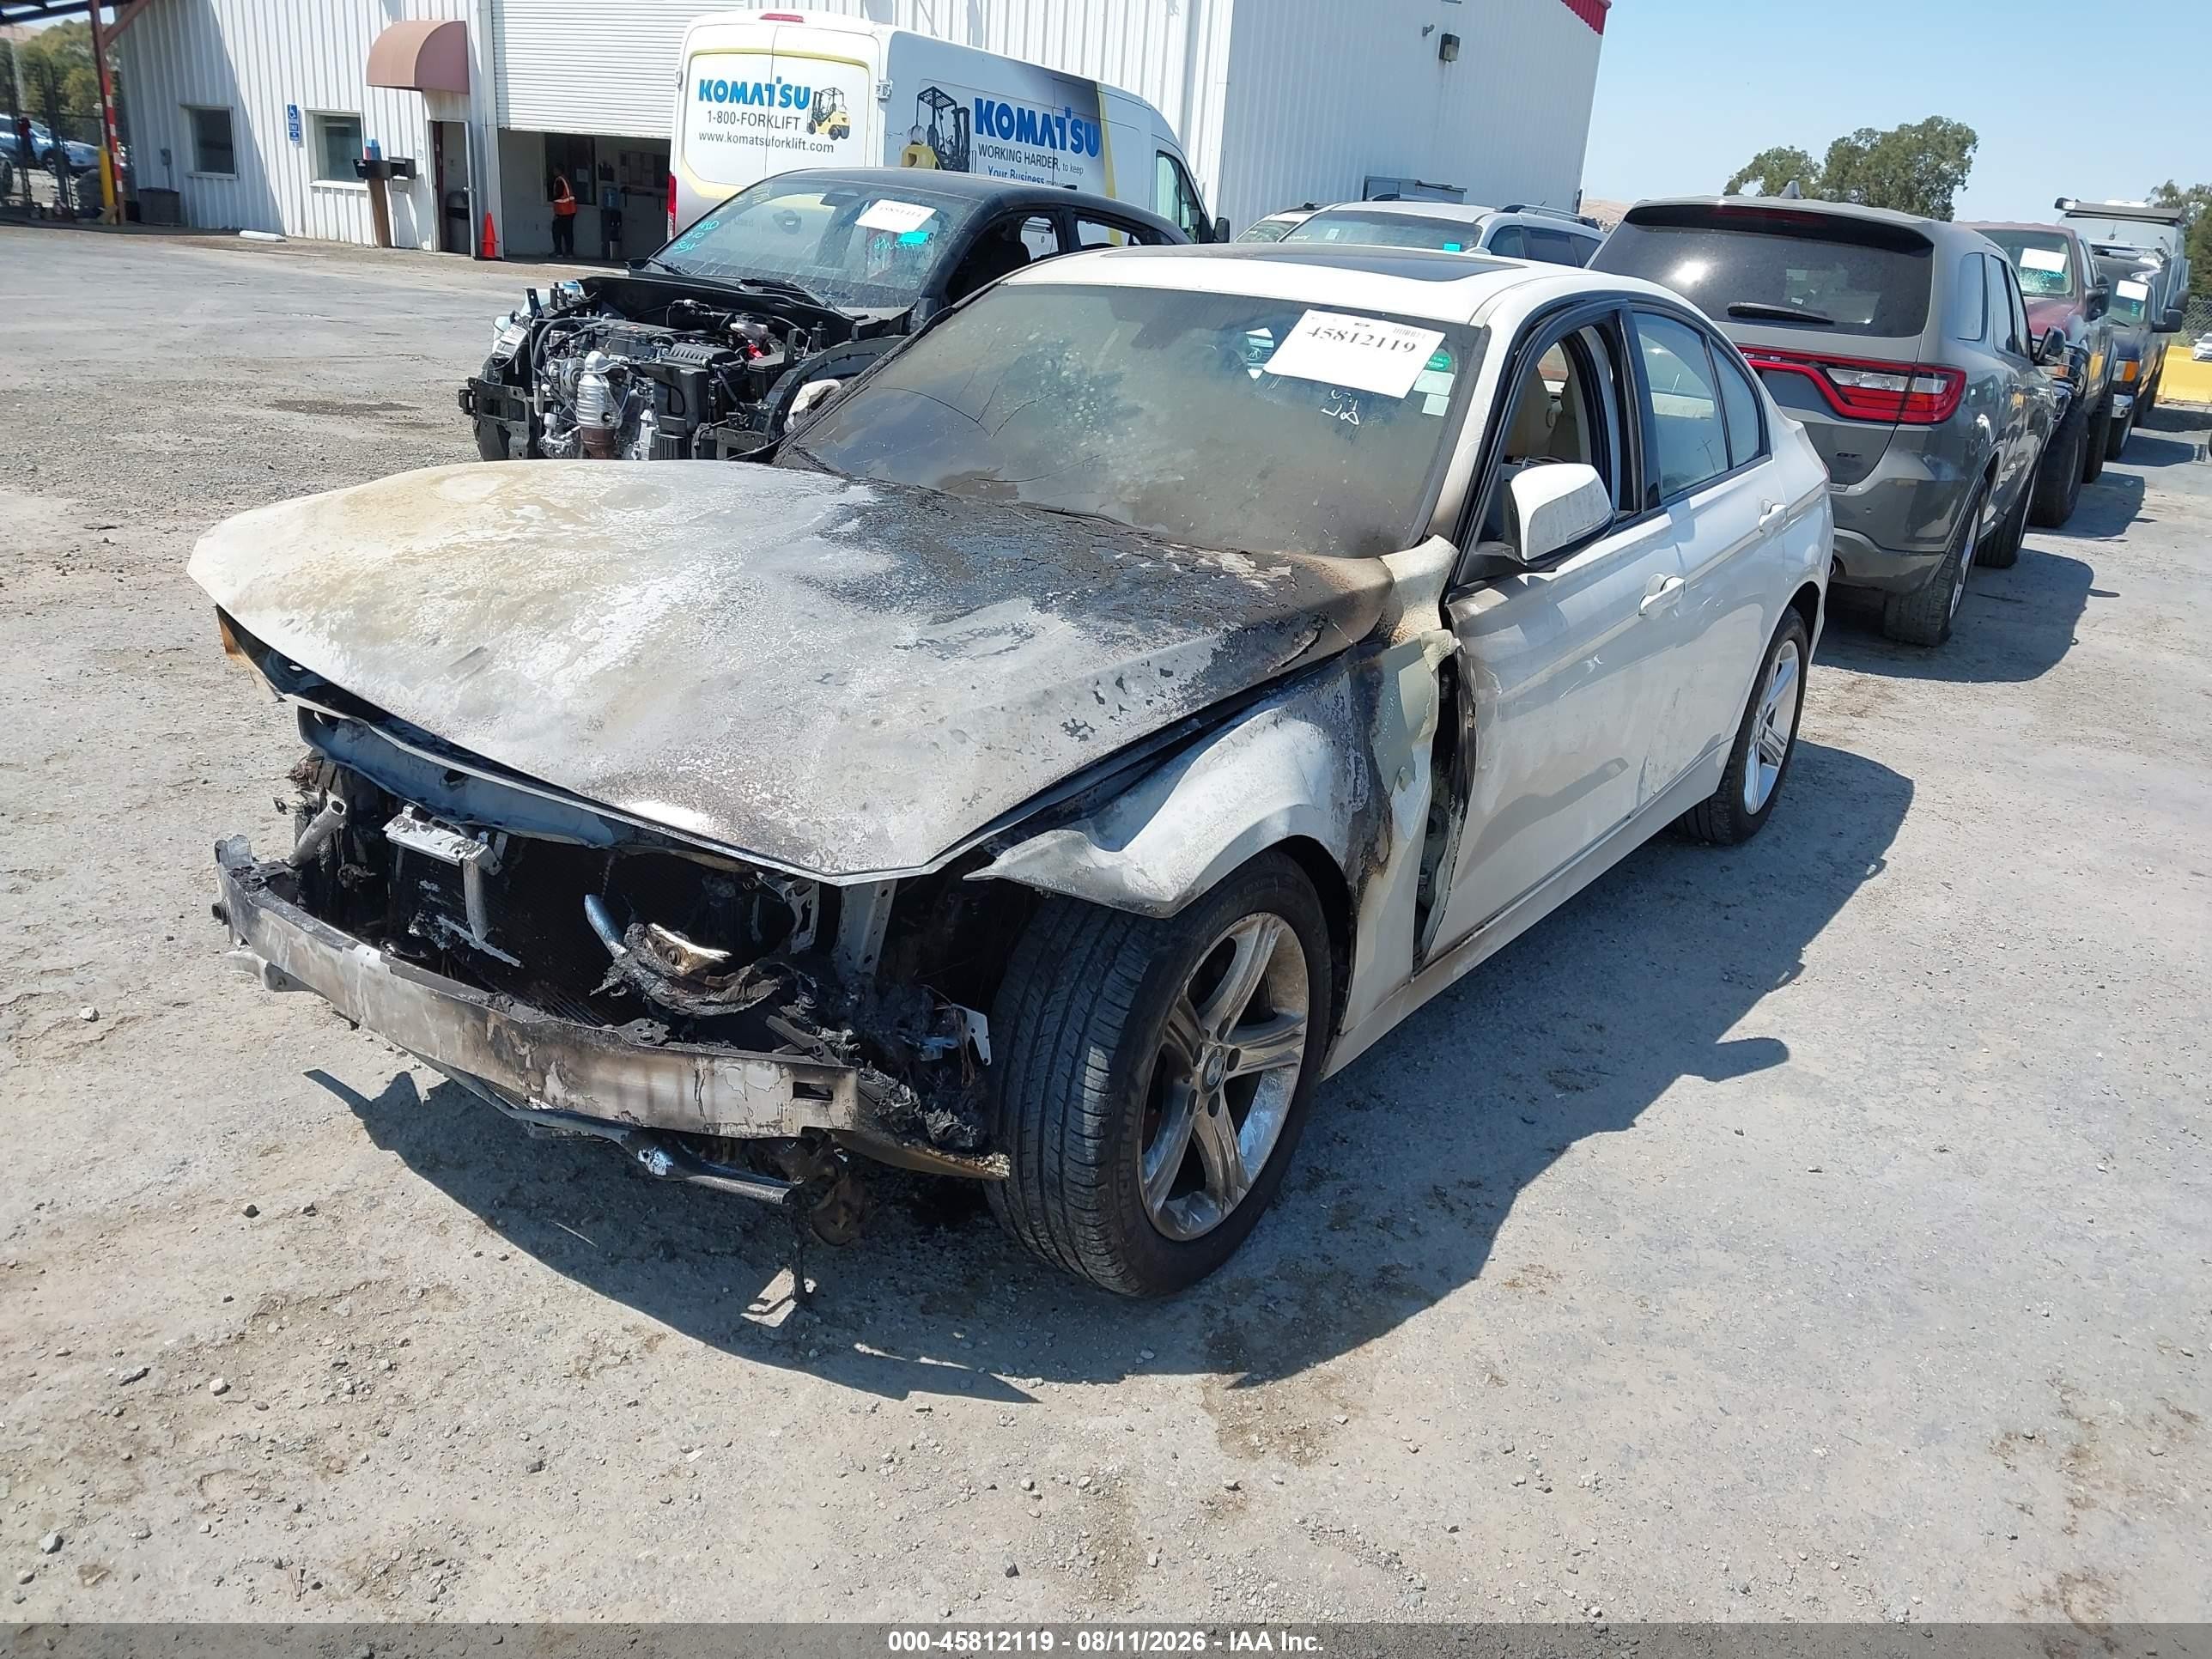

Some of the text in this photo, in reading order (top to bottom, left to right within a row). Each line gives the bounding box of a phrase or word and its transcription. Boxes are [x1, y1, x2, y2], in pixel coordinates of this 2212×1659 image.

[698, 76, 811, 110] KOMATSU
[708, 110, 801, 131] 1-800-FORKLIFT
[975, 97, 1100, 157] KOMATSU
[698, 131, 835, 154] www.komatsuforklift.com
[978, 143, 1084, 176] WORKING HARDER, to keep
[988, 165, 1008, 179] Your
[1010, 169, 1045, 184] Business
[1306, 326, 1417, 353] 45812119
